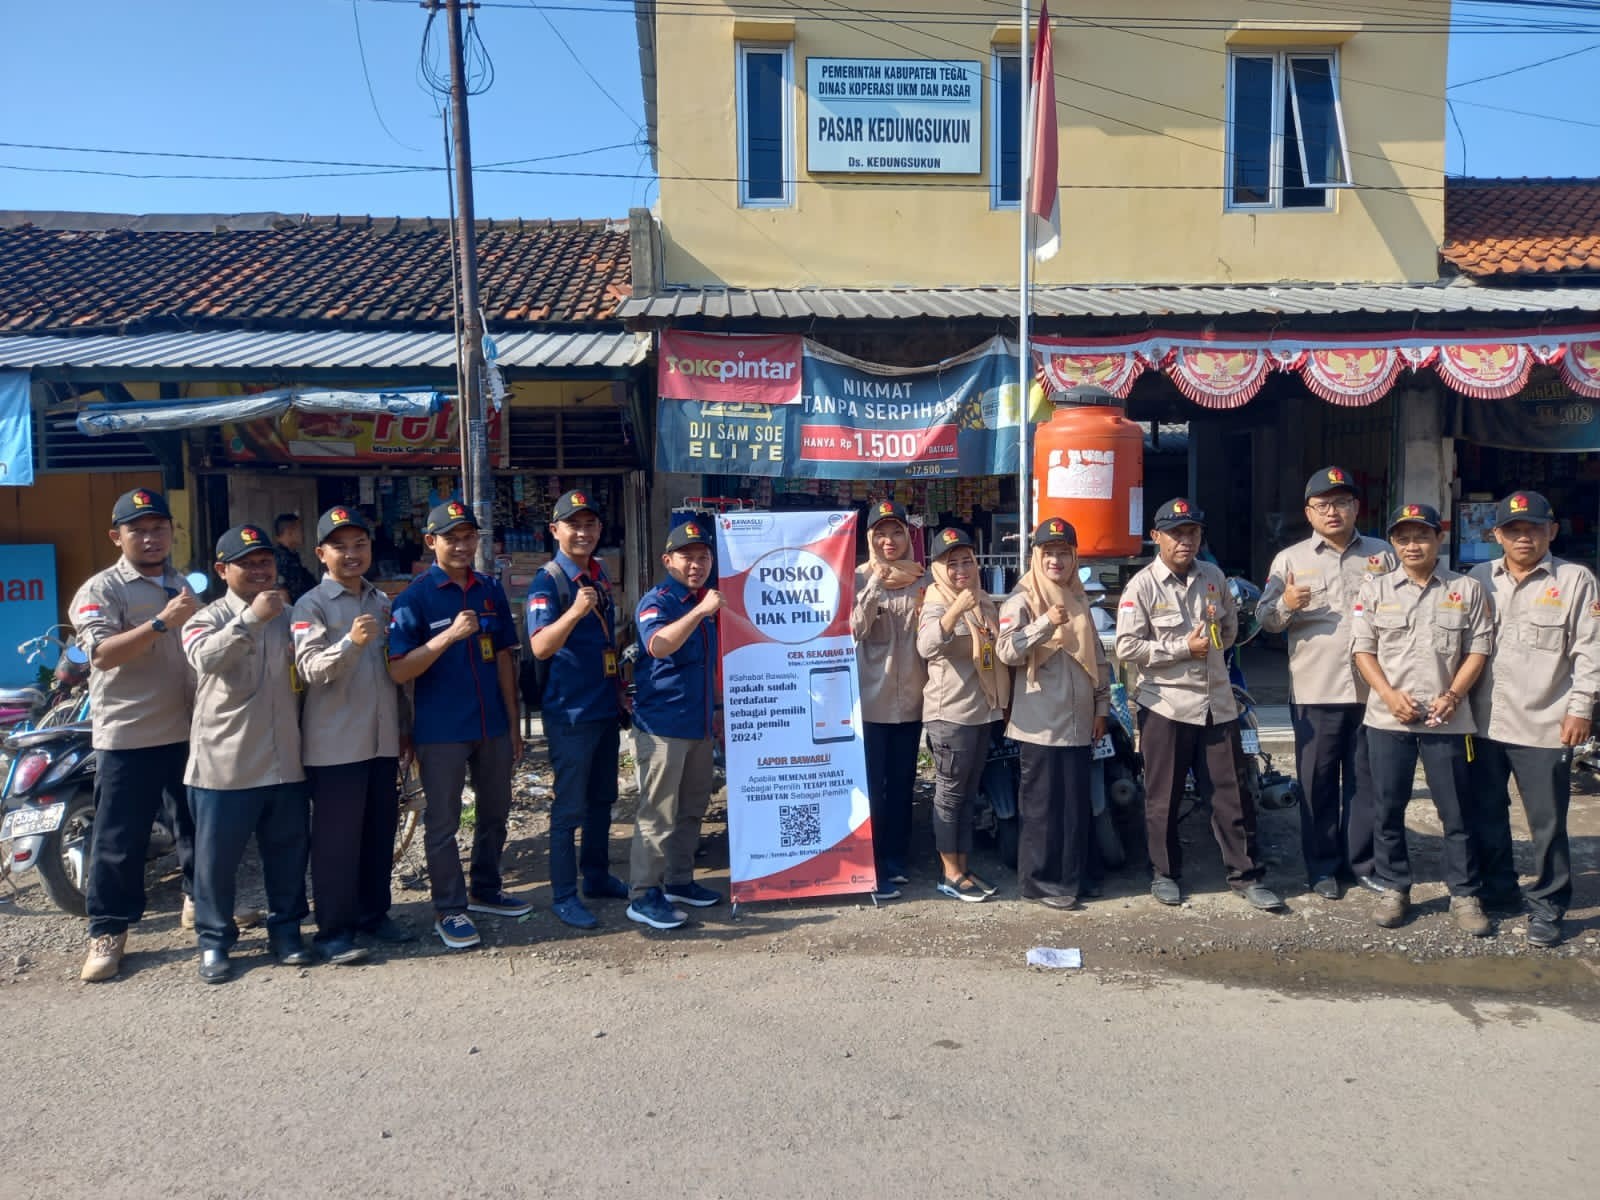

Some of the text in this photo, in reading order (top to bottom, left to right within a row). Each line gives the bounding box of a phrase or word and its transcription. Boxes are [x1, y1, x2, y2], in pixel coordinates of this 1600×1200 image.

[821, 65, 968, 81] PEMERINTAH KABUPATEN TEGAL
[818, 82, 971, 98] DINAS KOPERASI UKM DAN PASAR
[818, 117, 971, 143] PASAR KEDUNGSUKUN
[848, 156, 941, 169] Ds. KEDUNGSUKUN
[843, 378, 913, 399] NIKMAT
[802, 395, 959, 421] TANPA SERPIHAN
[689, 421, 783, 442] DJI SAM SOE
[689, 440, 783, 461] ELITE
[803, 437, 835, 449] HANYA
[840, 438, 853, 451] Rp
[759, 565, 824, 582] POSKO
[761, 588, 825, 606] KAWAL
[755, 610, 831, 625] HAK PILIH
[787, 651, 805, 660] CEK
[845, 647, 855, 656] DI
[729, 682, 797, 694] apakah sudah
[730, 706, 806, 718] sebagai pemilih
[730, 719, 790, 732] pada pemilu
[731, 732, 763, 743] 2024?
[757, 757, 788, 767] LAPOR
